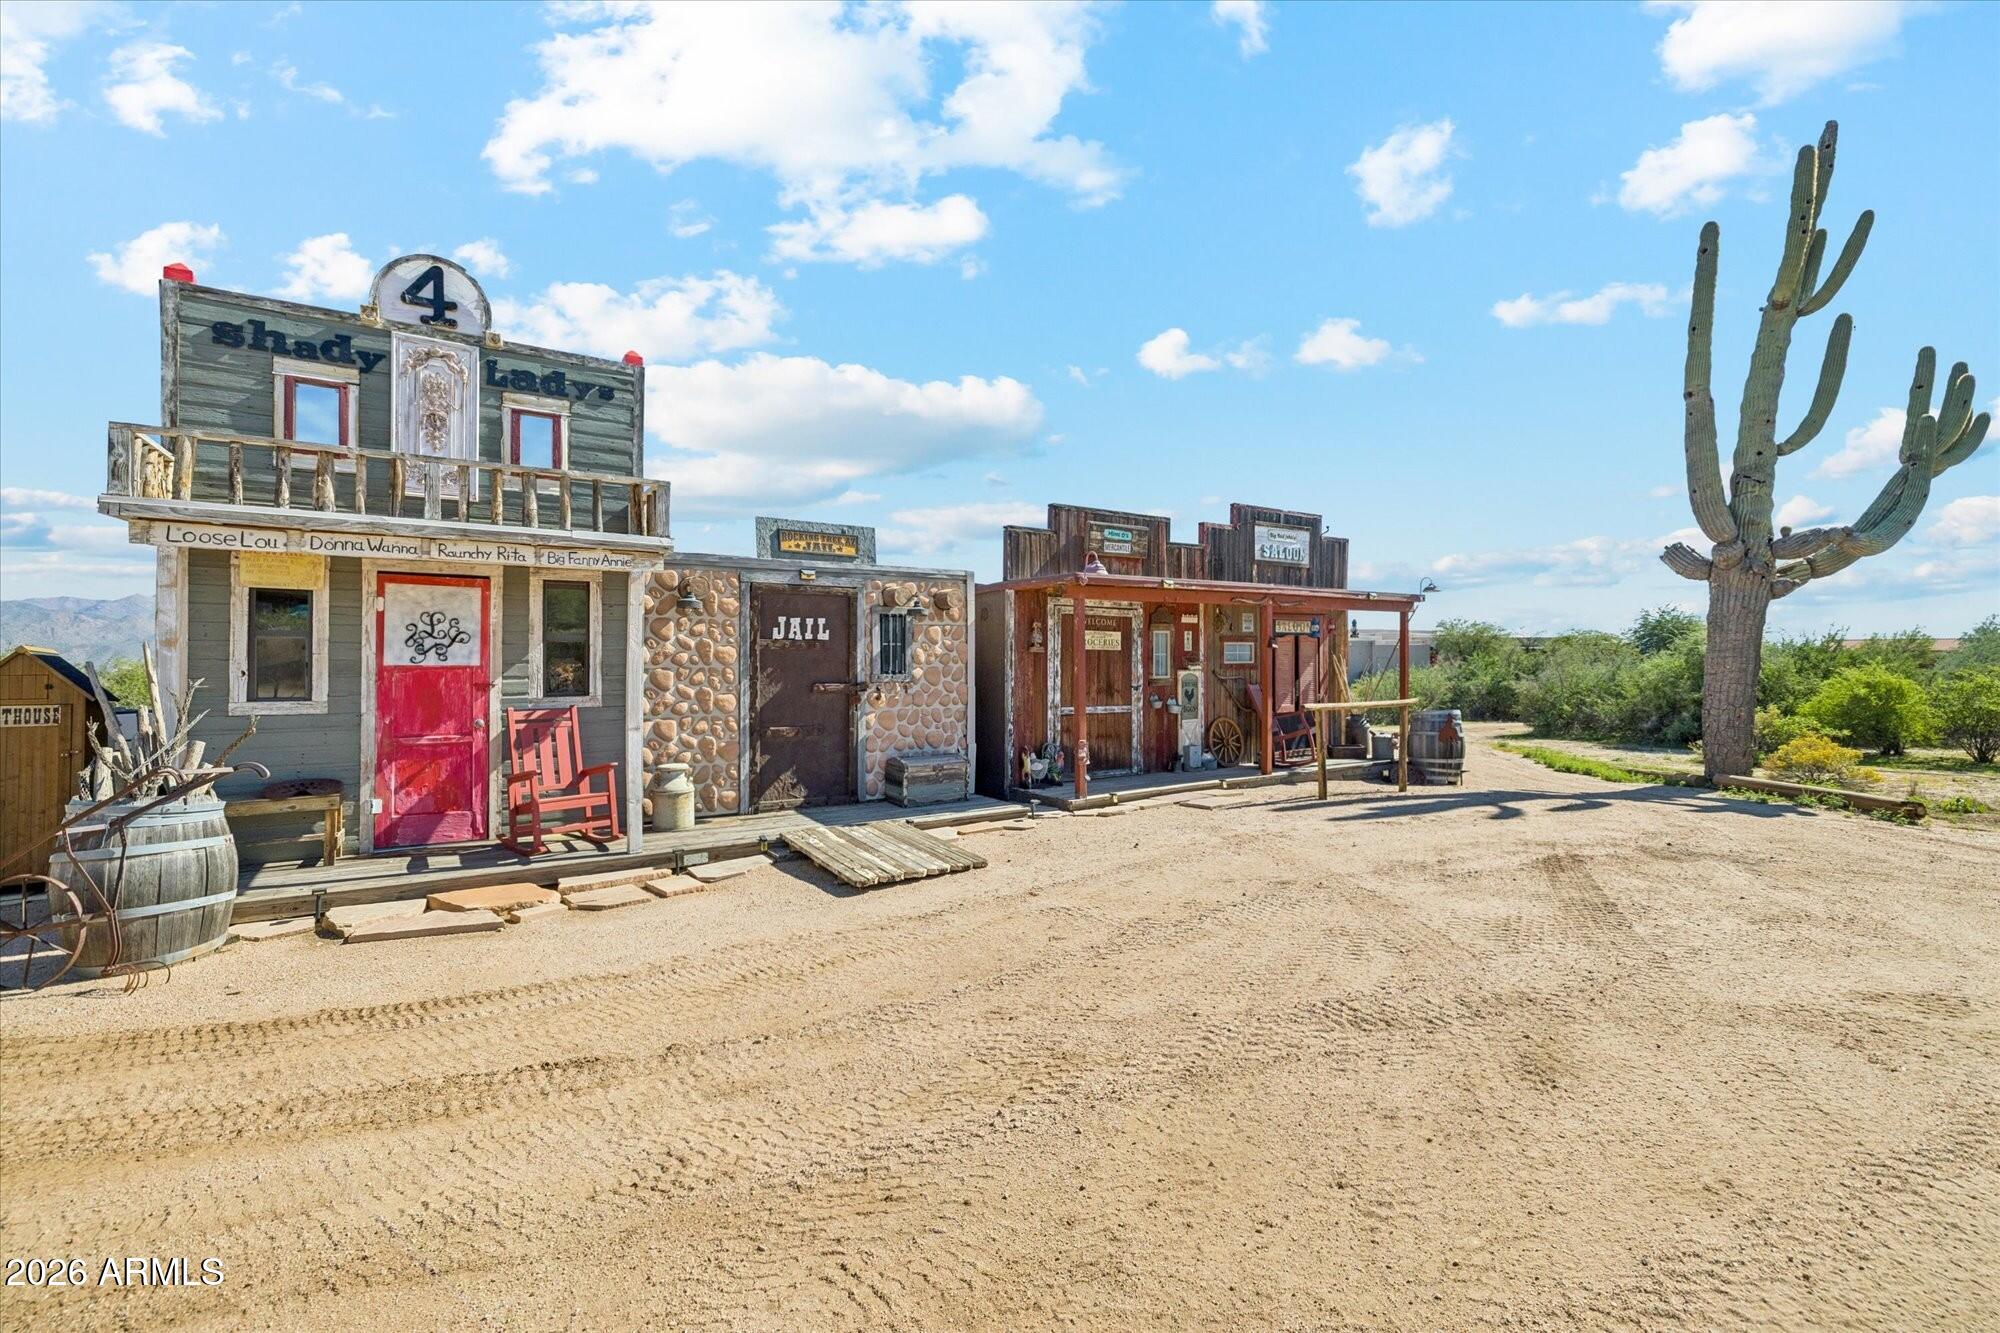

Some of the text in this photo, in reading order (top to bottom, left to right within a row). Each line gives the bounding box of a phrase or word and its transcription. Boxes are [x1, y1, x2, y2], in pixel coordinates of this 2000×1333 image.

[401, 265, 458, 329] 4
[212, 319, 386, 373] shady
[166, 525, 279, 549] Loose Lou
[310, 535, 419, 555] Donna Wanna
[781, 531, 820, 542] ROCKING
[438, 543, 527, 562] Raunchy Rita
[1104, 543, 1131, 552] MERCANTILE
[1261, 544, 1306, 561] SALOON
[547, 552, 632, 567] Big Fanny Annie
[772, 616, 830, 640] JAIL
[1087, 638, 1120, 647] OCERIES
[2, 707, 60, 724] THOUSE
